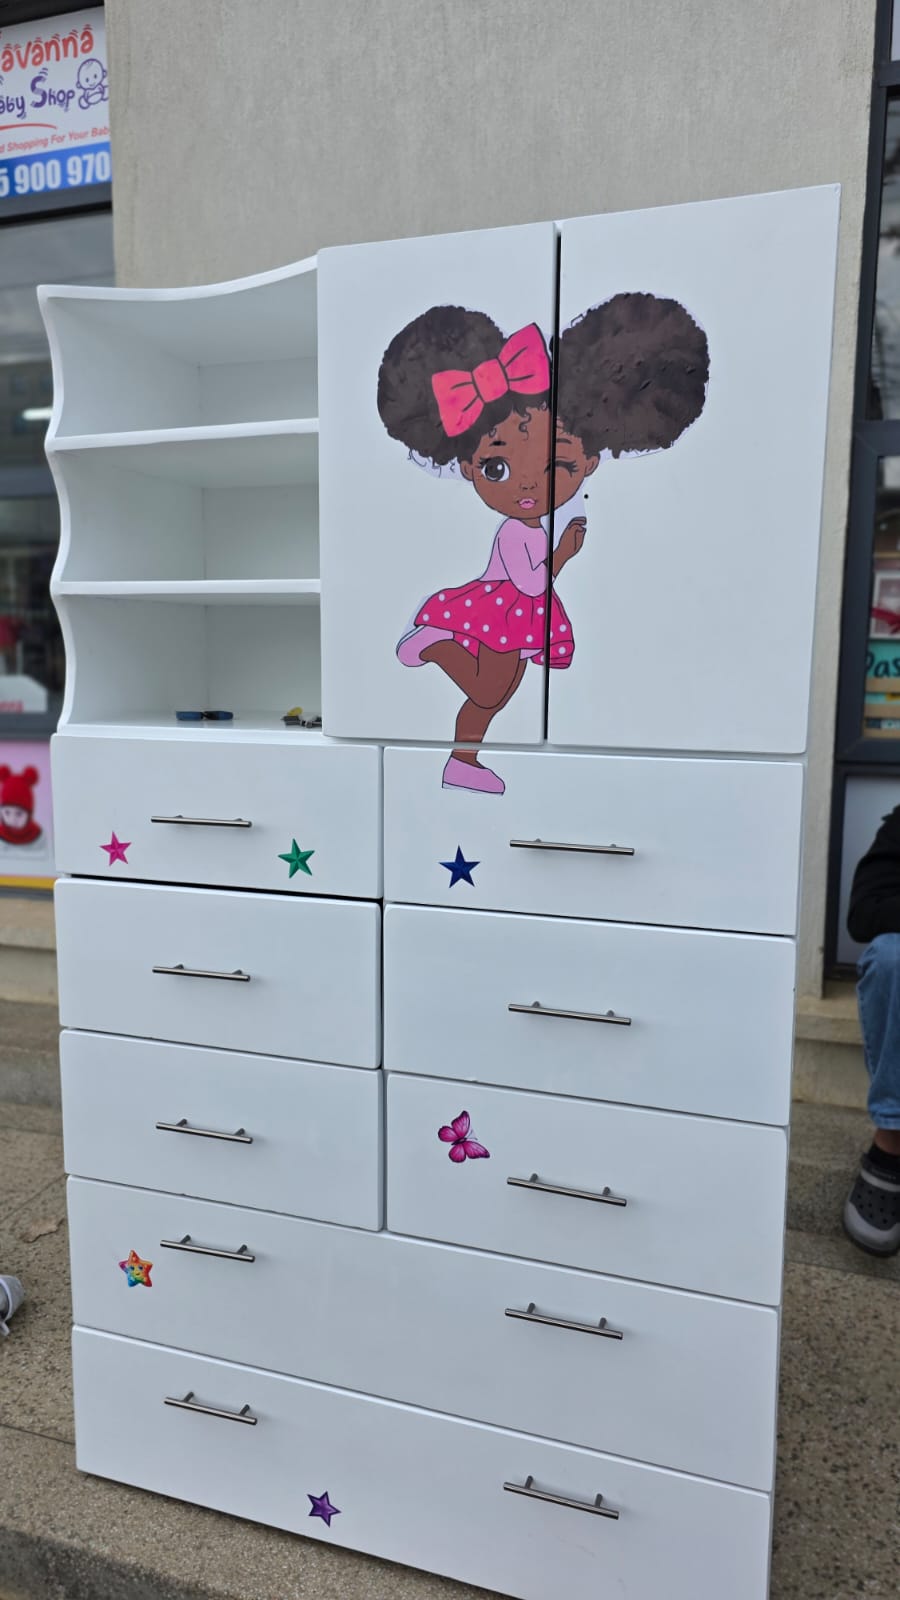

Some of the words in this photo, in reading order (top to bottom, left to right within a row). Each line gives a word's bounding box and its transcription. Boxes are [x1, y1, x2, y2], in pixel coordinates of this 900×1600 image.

[0, 27, 94, 72] avanna
[0, 95, 26, 118] aby
[30, 74, 75, 110] Shop
[7, 138, 48, 152] Shopping
[51, 134, 65, 144] For
[68, 130, 88, 140] Your
[91, 127, 110, 137] Bab
[14, 159, 61, 194] 900
[67, 151, 110, 186] 970
